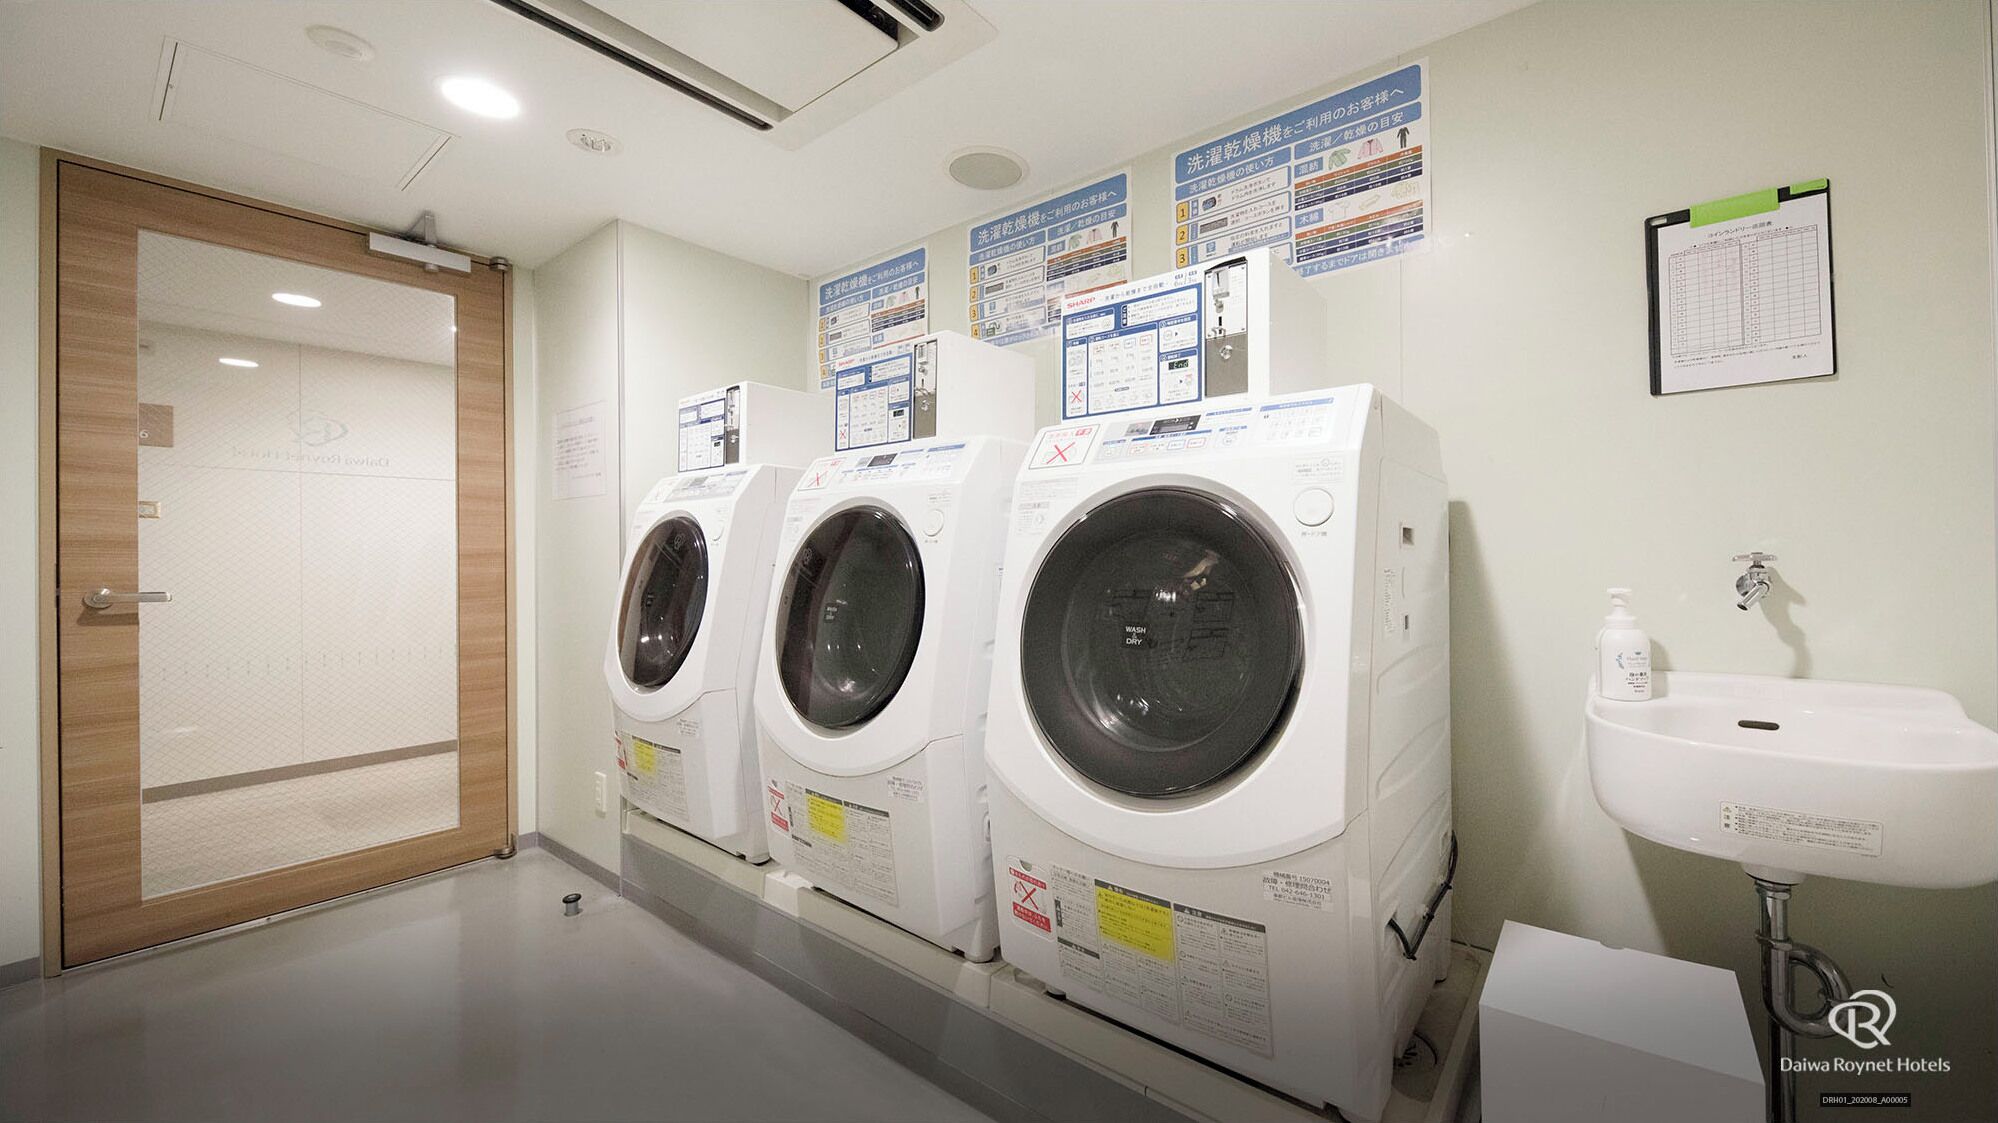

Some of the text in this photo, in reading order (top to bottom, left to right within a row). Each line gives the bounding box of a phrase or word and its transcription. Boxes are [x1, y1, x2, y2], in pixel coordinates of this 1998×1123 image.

[1187, 87, 1404, 174] 洗濯乾燥機をご利用のお客様へ
[1310, 111, 1404, 152] 洗濯／乾燥の目安
[1188, 156, 1275, 194] 洗濯乾燥機の使い方
[977, 191, 1117, 245] 洗濯乾燥機をご利用のお客様へ
[1066, 297, 1096, 309] SHARP
[1125, 626, 1146, 634] WASH
